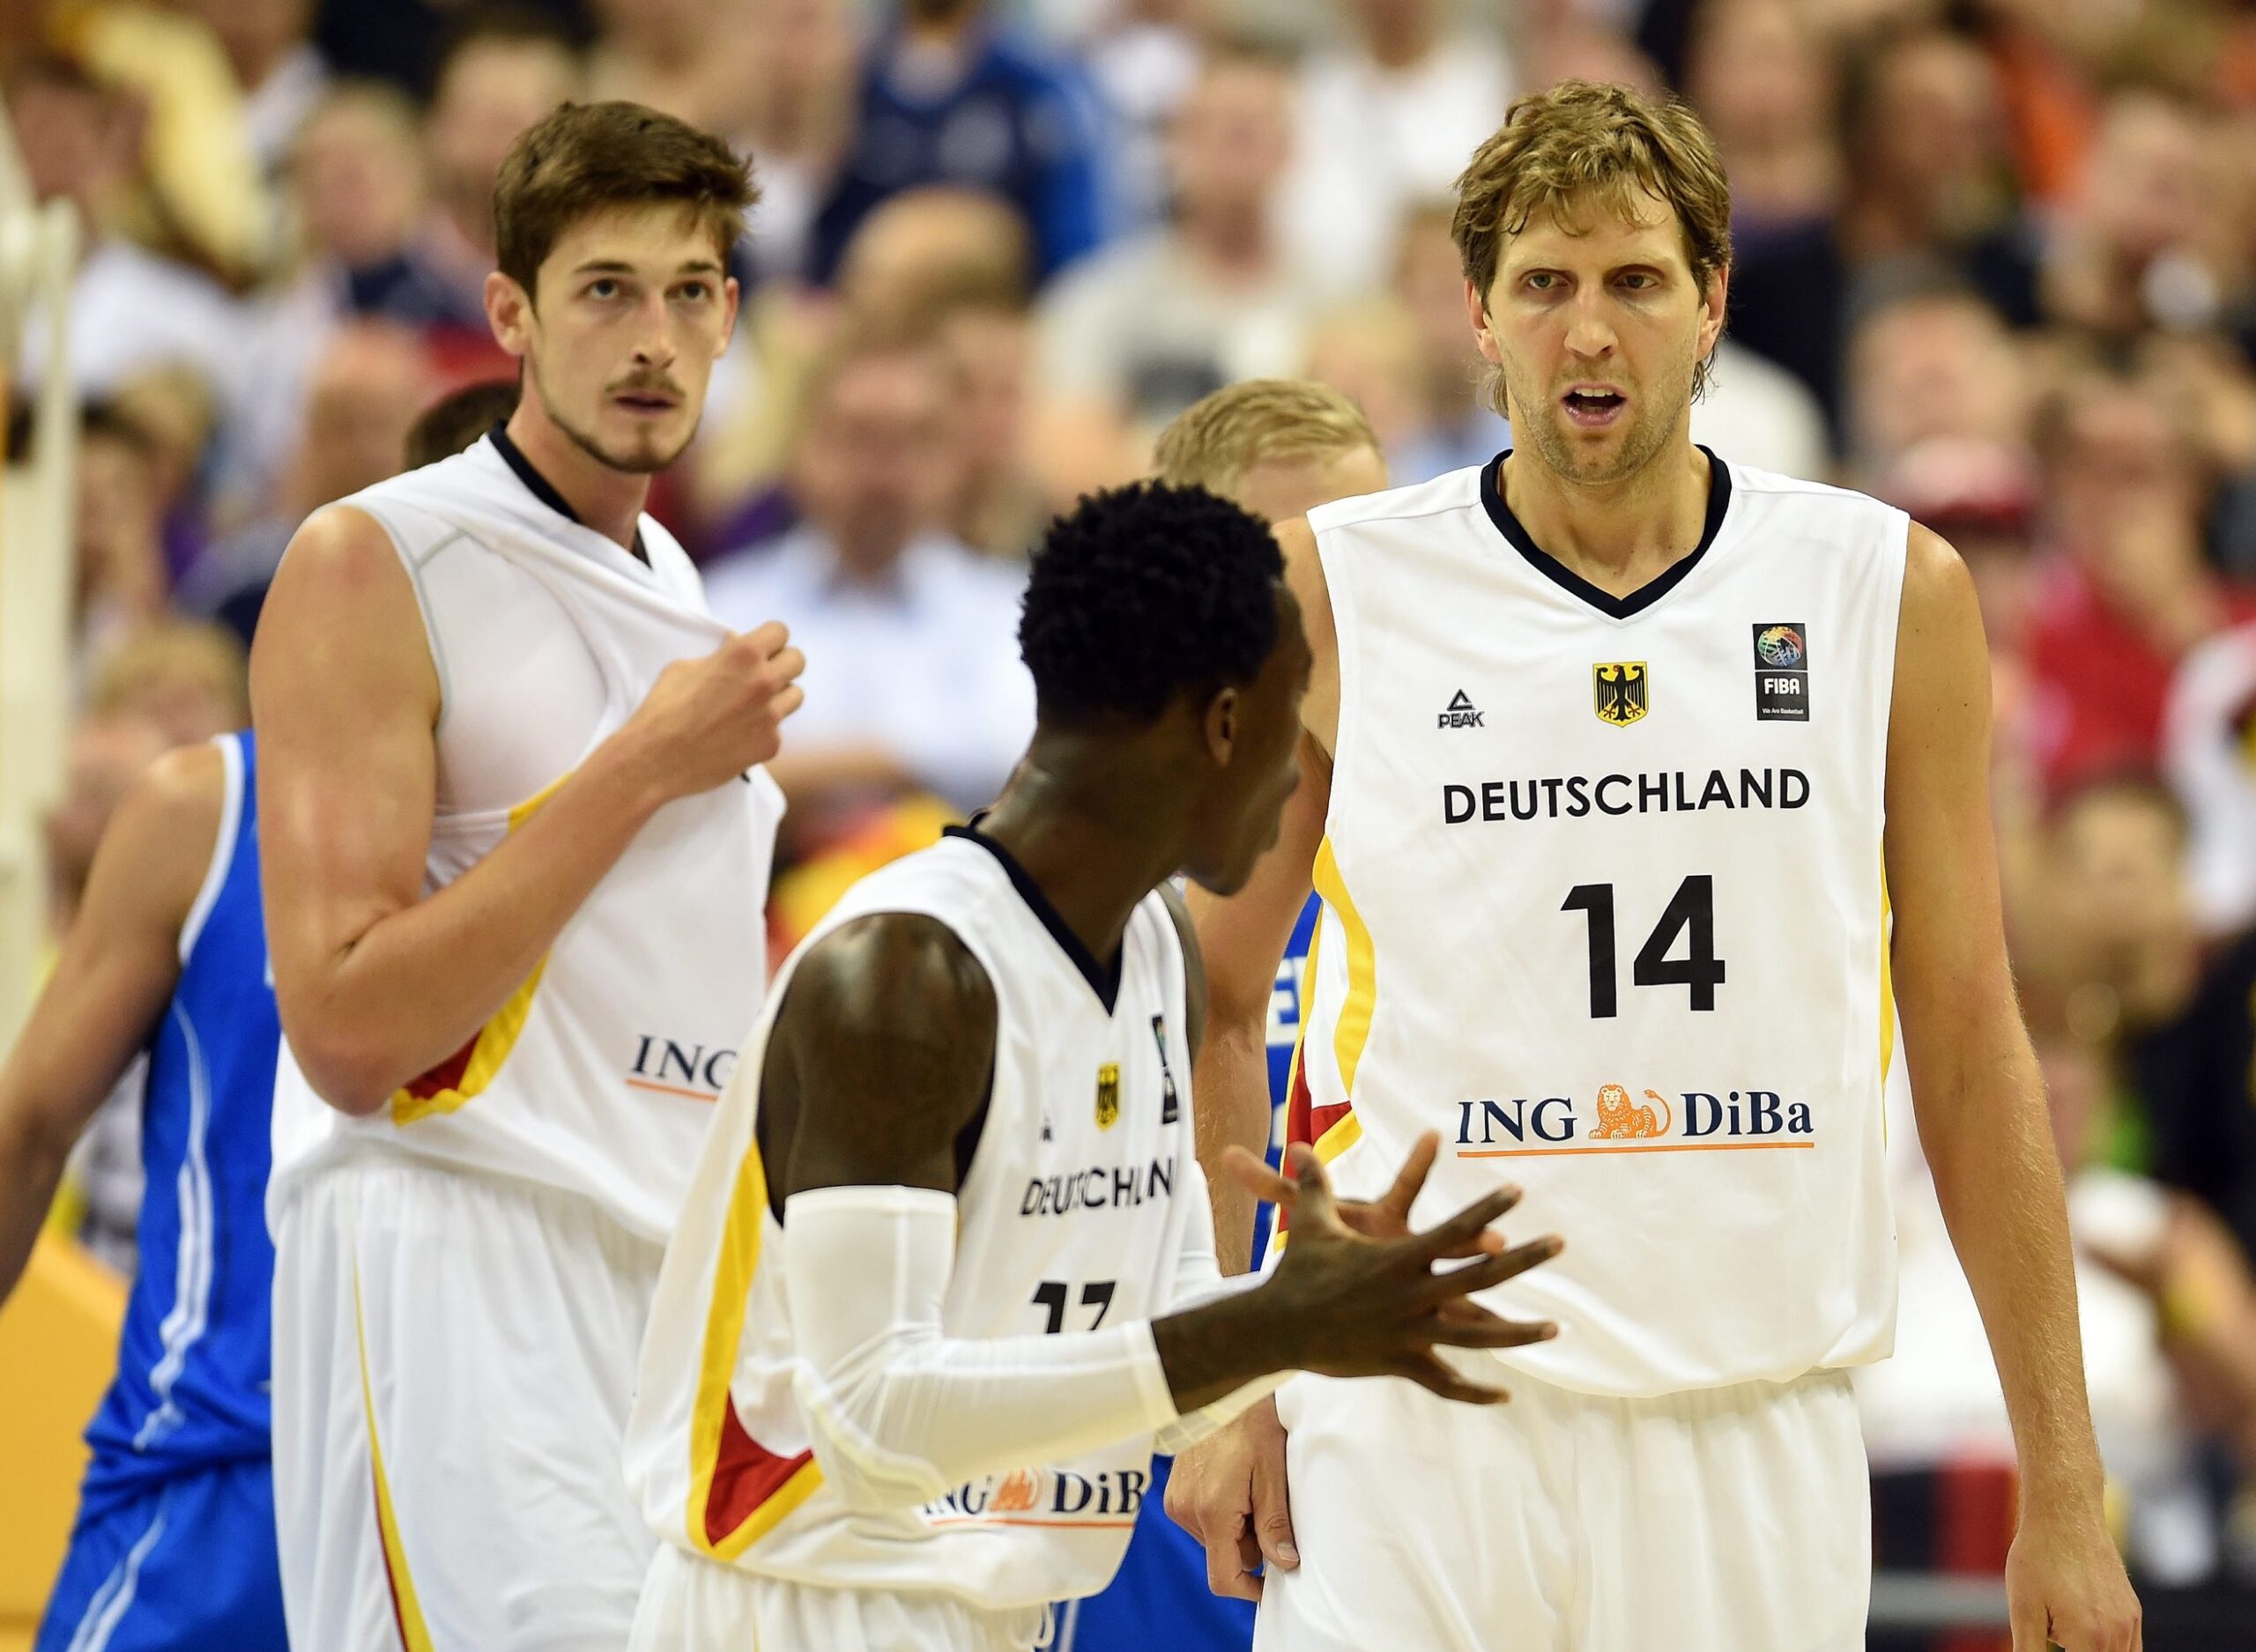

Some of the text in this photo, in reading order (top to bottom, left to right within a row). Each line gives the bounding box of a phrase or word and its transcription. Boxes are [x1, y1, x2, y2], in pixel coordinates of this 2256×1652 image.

[1763, 678, 1800, 695] FIBA
[1437, 710, 1485, 730] PEAK
[1443, 768, 1810, 824] DEUTSCHLAND
[1561, 874, 1725, 1019] 14
[1456, 1091, 1814, 1144] ING DiBa
[1050, 1471, 1144, 1515] DiB
